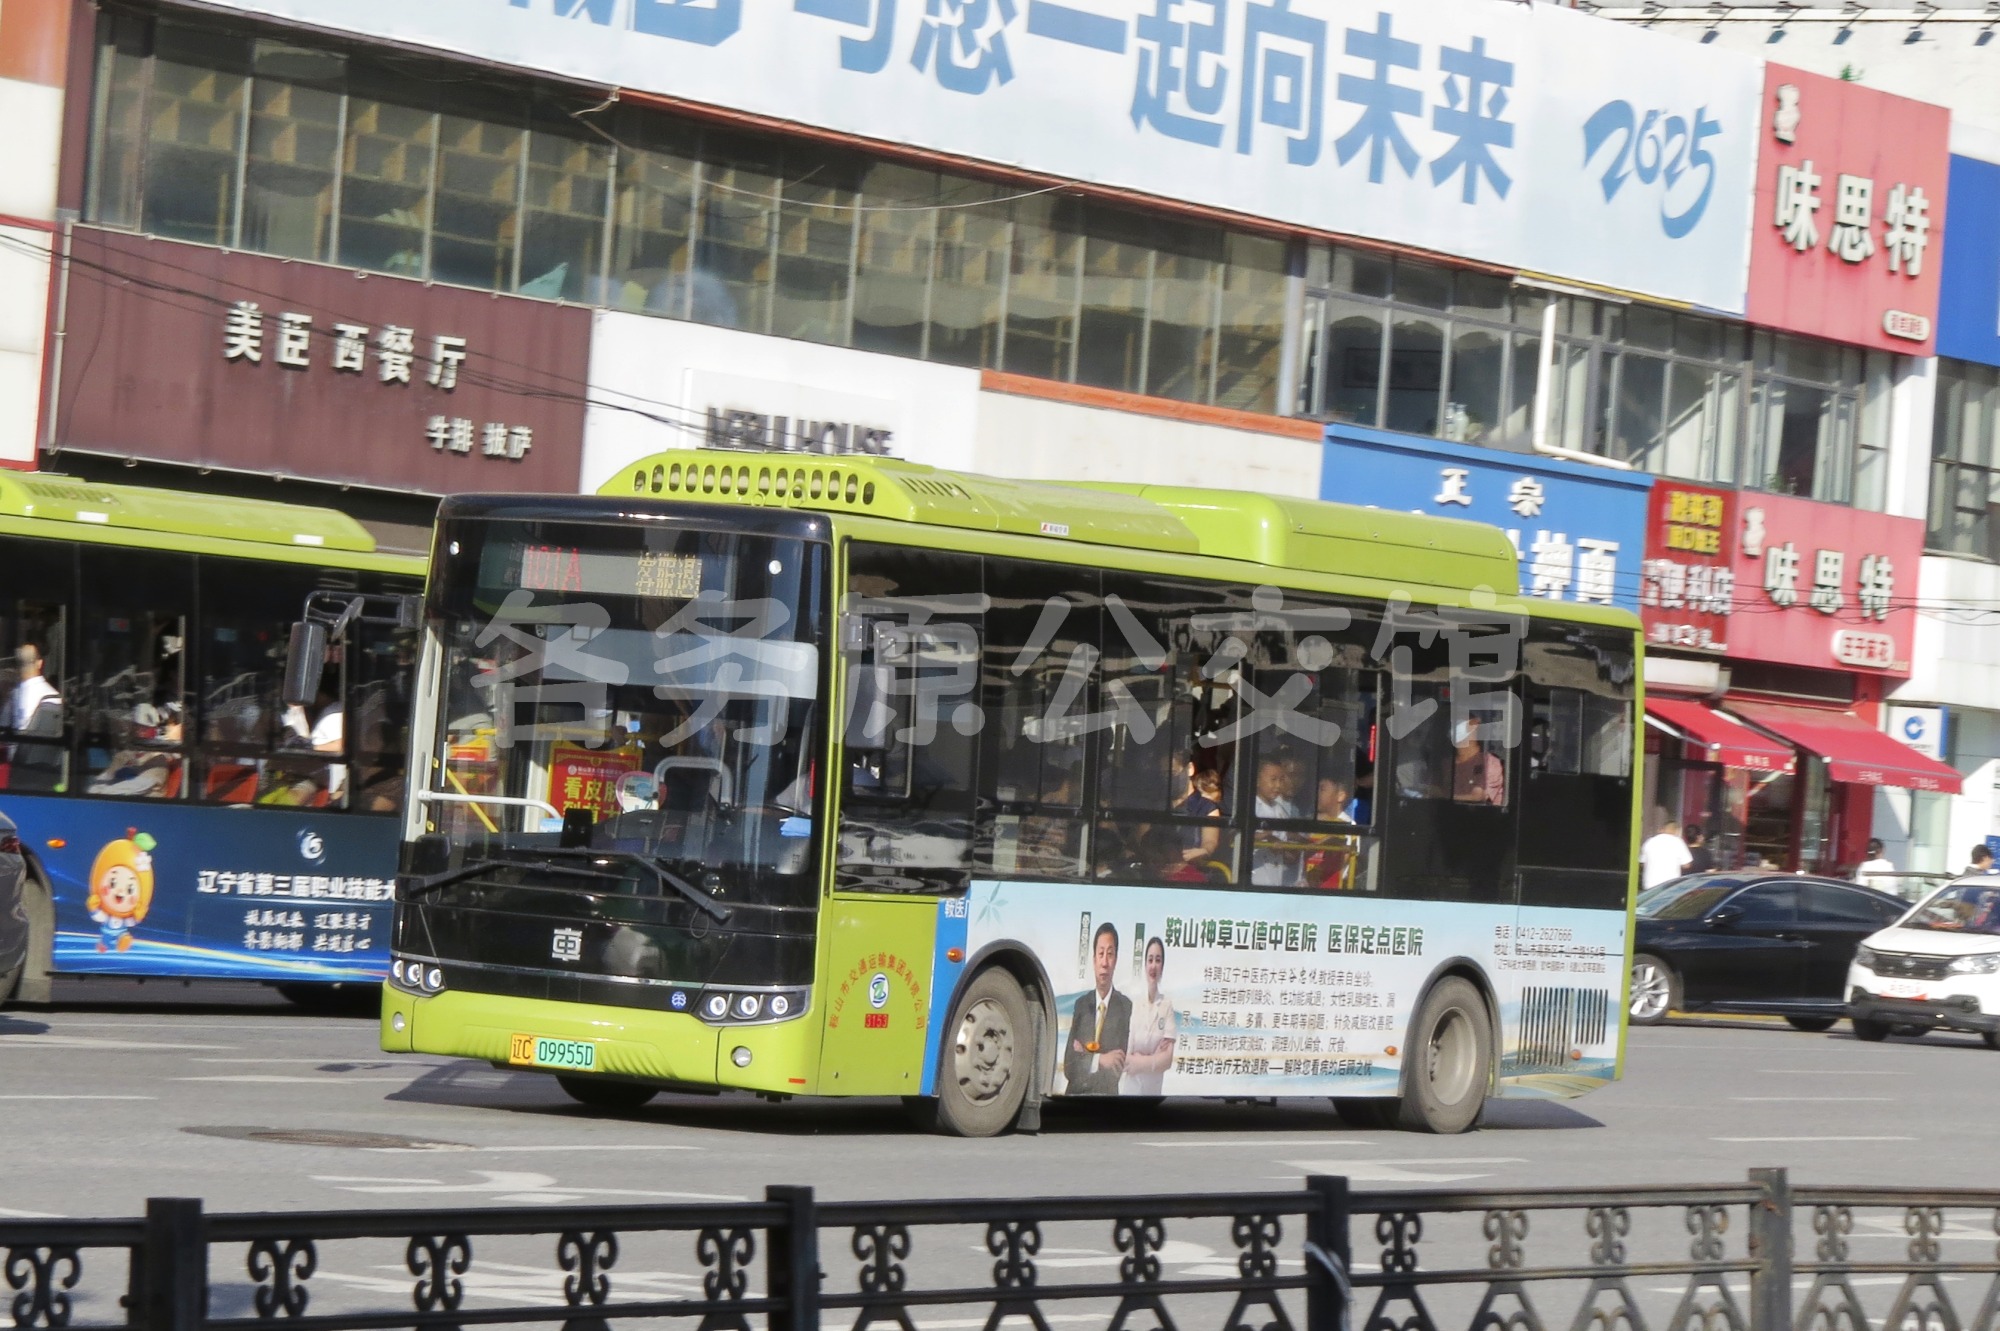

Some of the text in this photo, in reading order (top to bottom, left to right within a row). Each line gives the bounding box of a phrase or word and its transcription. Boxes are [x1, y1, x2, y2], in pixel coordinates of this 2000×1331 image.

[1774, 160, 1930, 277] 味思特
[426, 415, 473, 454] 牛排
[1434, 468, 1546, 517] 正宗
[1765, 542, 1895, 621] 味思特
[1165, 916, 1424, 956] 鞍山神草立德中医院 医保定点医院
[866, 1015, 889, 1028] 3153
